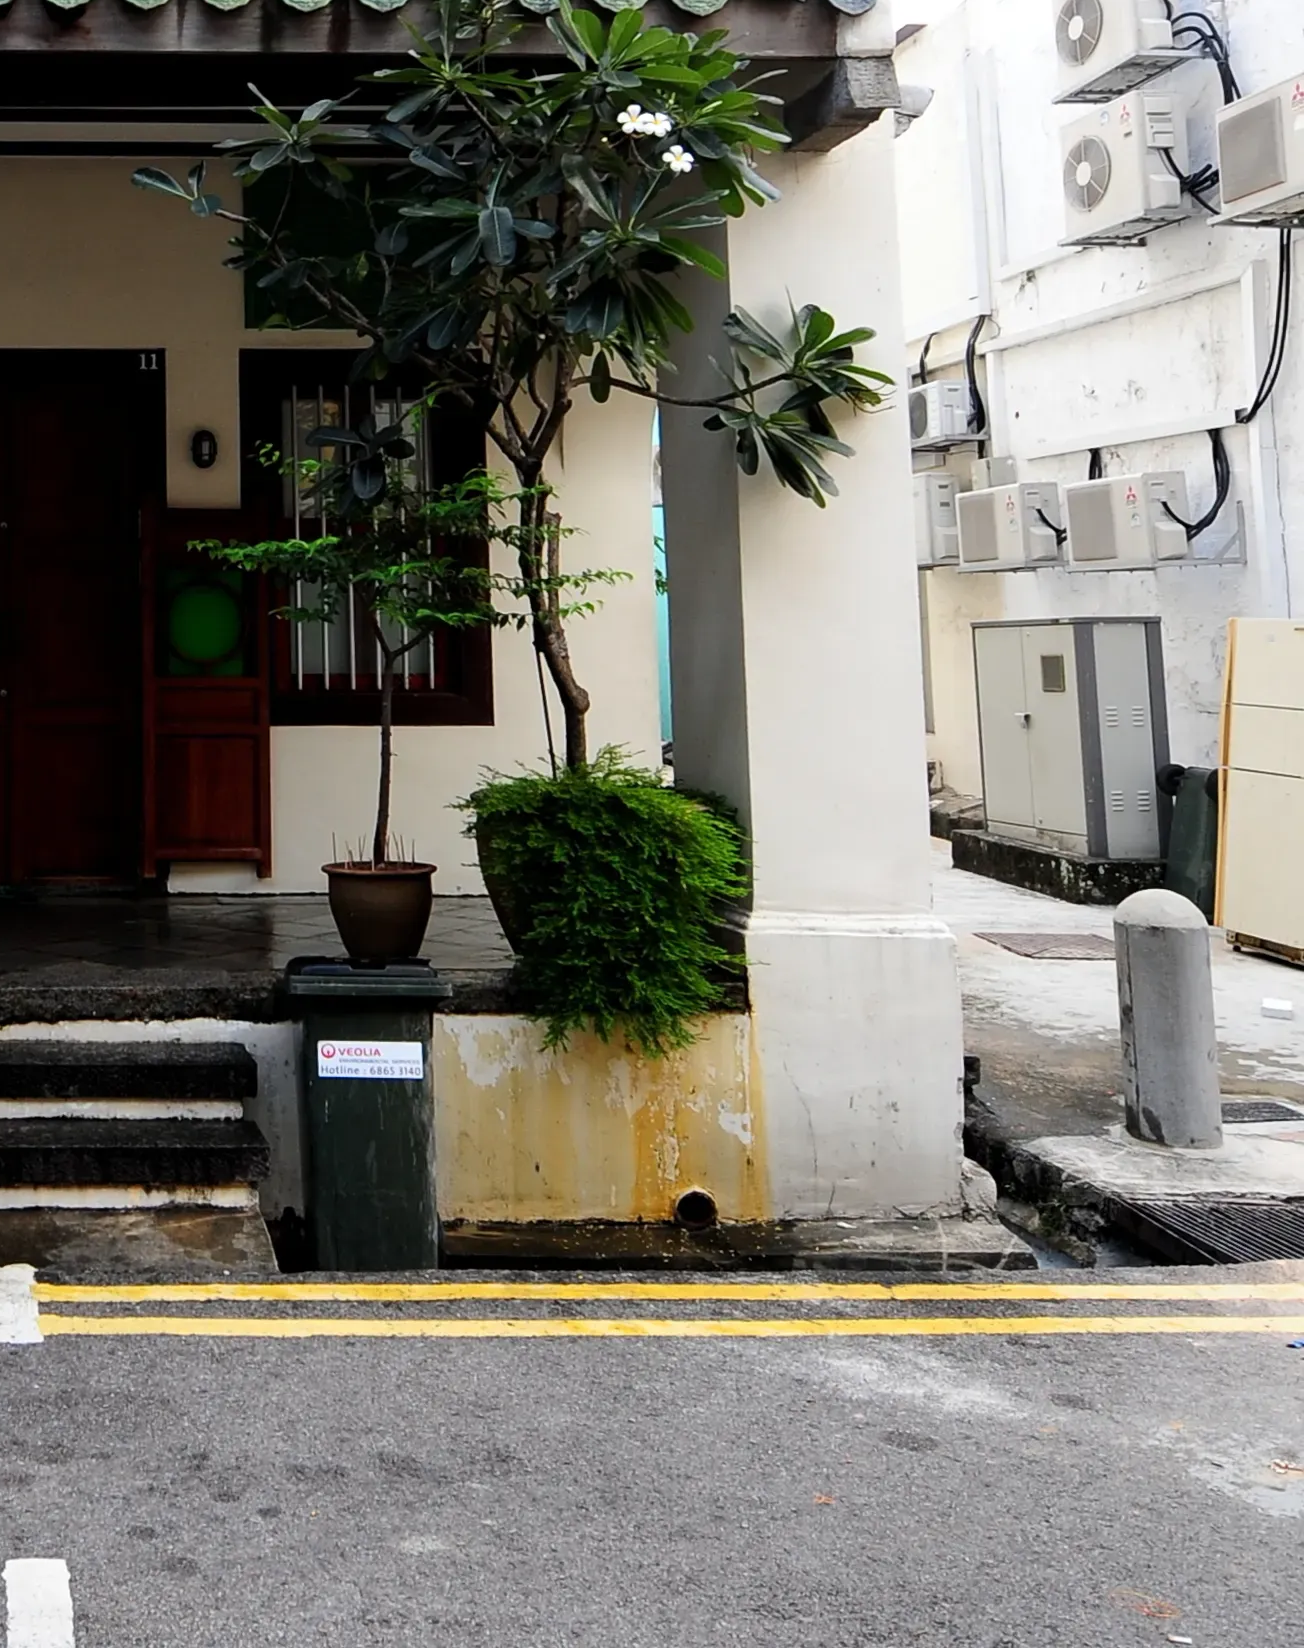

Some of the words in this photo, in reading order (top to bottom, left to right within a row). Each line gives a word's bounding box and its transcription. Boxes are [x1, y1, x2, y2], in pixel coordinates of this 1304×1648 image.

[139, 353, 158, 370] 11
[338, 1047, 381, 1057] VEOLIA
[321, 1065, 360, 1074] Hotline
[369, 1066, 395, 1075] 6865
[399, 1066, 421, 1076] 3140
